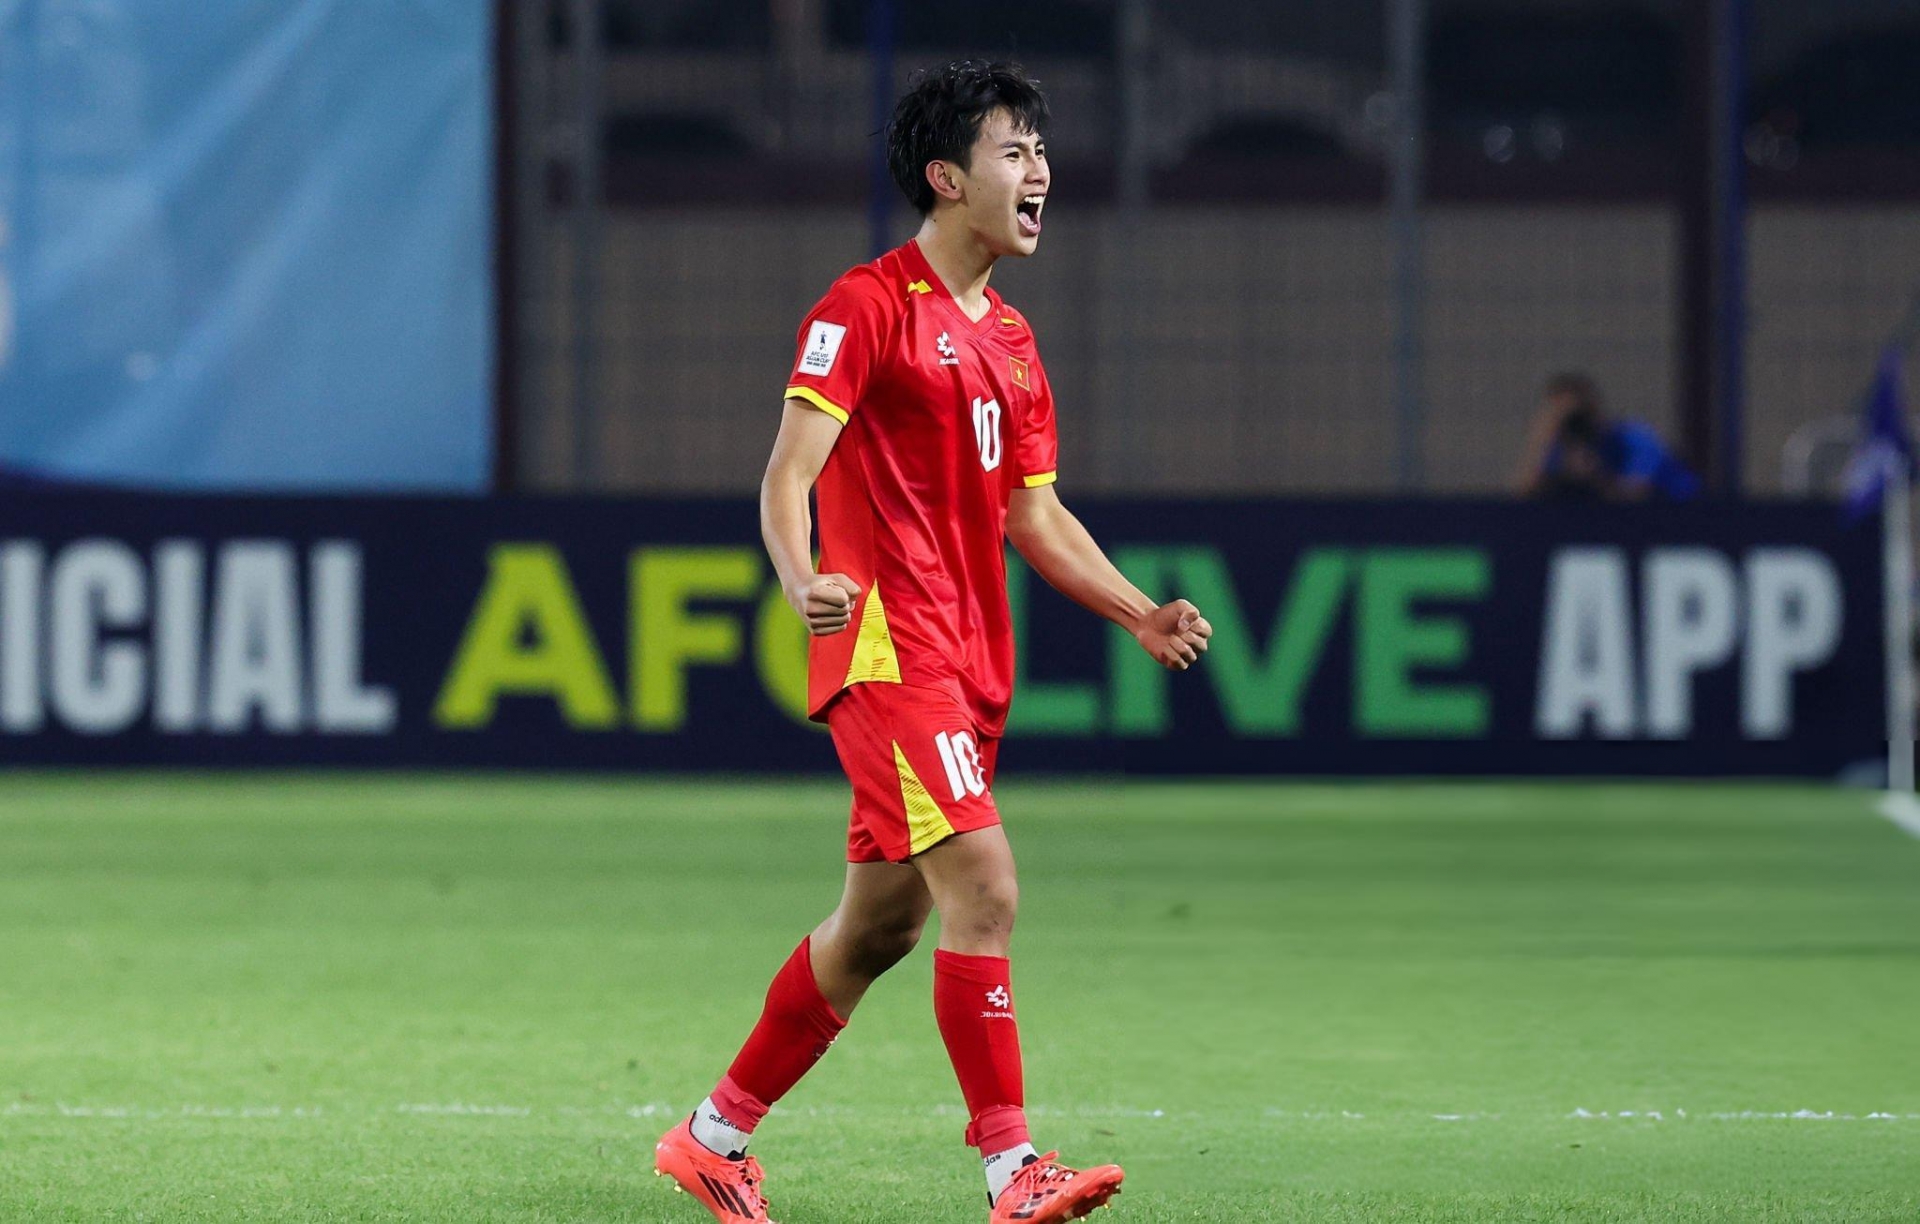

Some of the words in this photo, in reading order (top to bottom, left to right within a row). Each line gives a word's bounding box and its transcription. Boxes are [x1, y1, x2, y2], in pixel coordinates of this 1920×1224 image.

[972, 396, 1002, 472] 10
[1003, 546, 1492, 737] LIVE
[1534, 546, 1844, 739] APP
[934, 730, 986, 802] 10
[709, 1114, 740, 1130] adida
